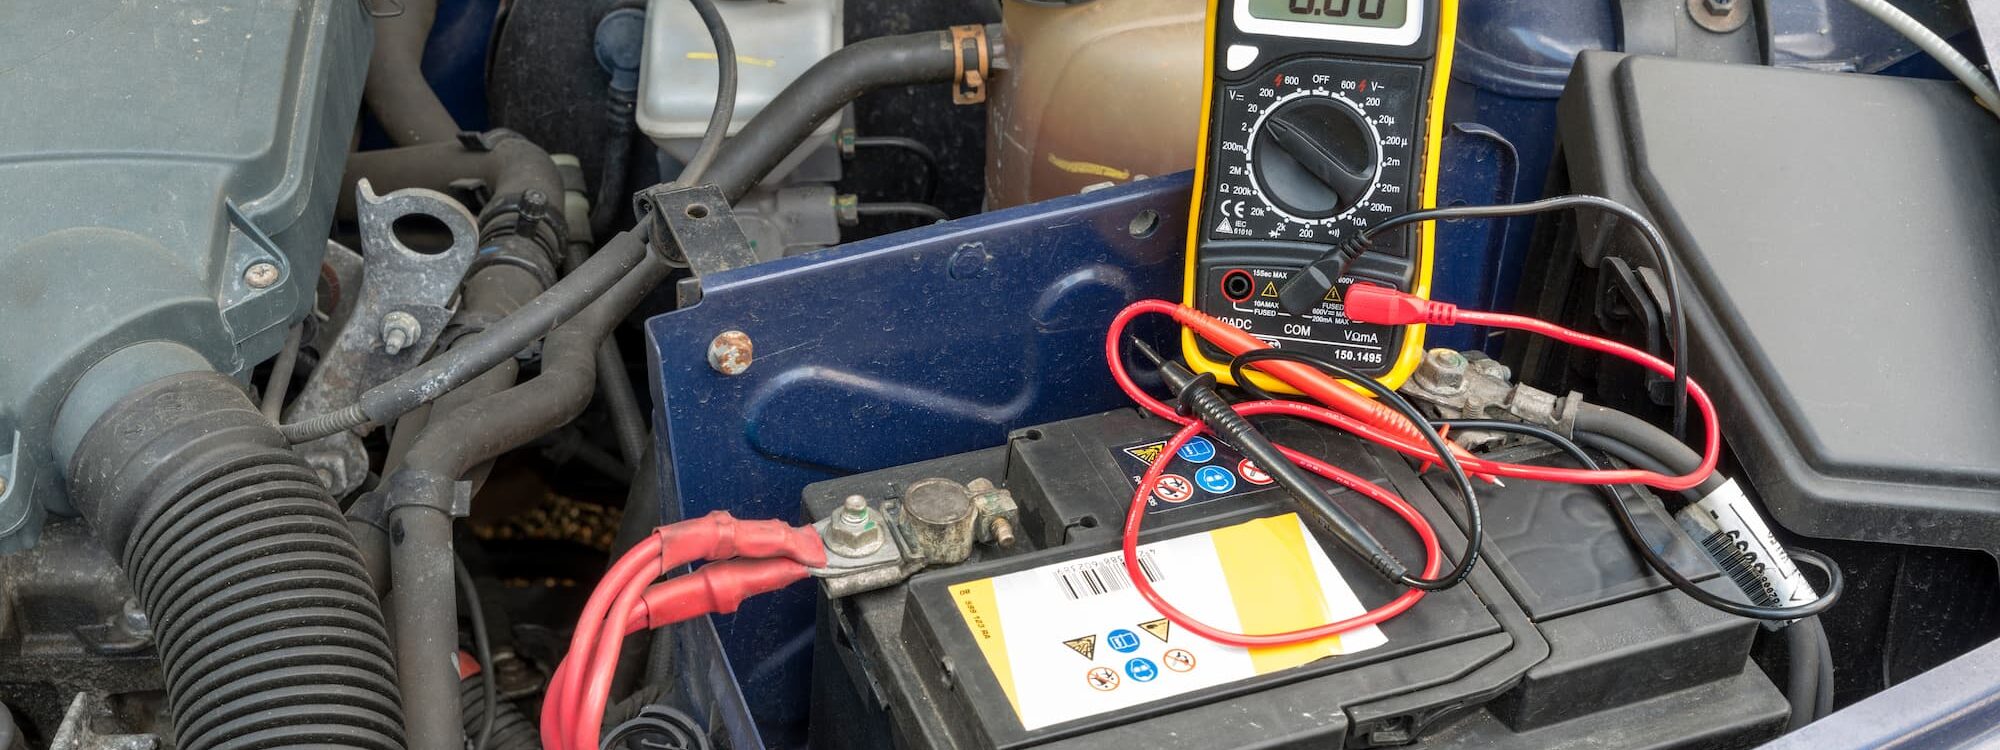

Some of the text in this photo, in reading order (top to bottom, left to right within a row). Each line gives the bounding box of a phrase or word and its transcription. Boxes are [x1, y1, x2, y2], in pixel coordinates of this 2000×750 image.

[1284, 76, 1299, 85] 600
[1312, 74, 1330, 84] OFF
[1341, 80, 1356, 90] 600
[1259, 87, 1274, 97] 200
[1365, 97, 1380, 106] 200
[1247, 103, 1258, 112] 20
[1241, 122, 1247, 131] 2
[1222, 141, 1244, 152] 200m
[1387, 157, 1400, 166] 2m
[1229, 165, 1242, 175] 2M
[1233, 185, 1252, 196] 200k
[1381, 183, 1400, 193] 20m
[1250, 206, 1265, 217] 20k
[1370, 202, 1392, 213] 200m
[1235, 220, 1247, 228] IEC
[1276, 221, 1286, 232] 2k
[1352, 217, 1367, 227] 10A
[1299, 228, 1314, 238] 200
[1272, 271, 1288, 280] MAX
[1322, 302, 1345, 310] FUSED
[1253, 308, 1277, 317] FUSED
[1335, 310, 1347, 318] MA
[1334, 317, 1350, 325] MAX
[1283, 323, 1311, 337] COM
[1334, 349, 1382, 364] 150.1495
